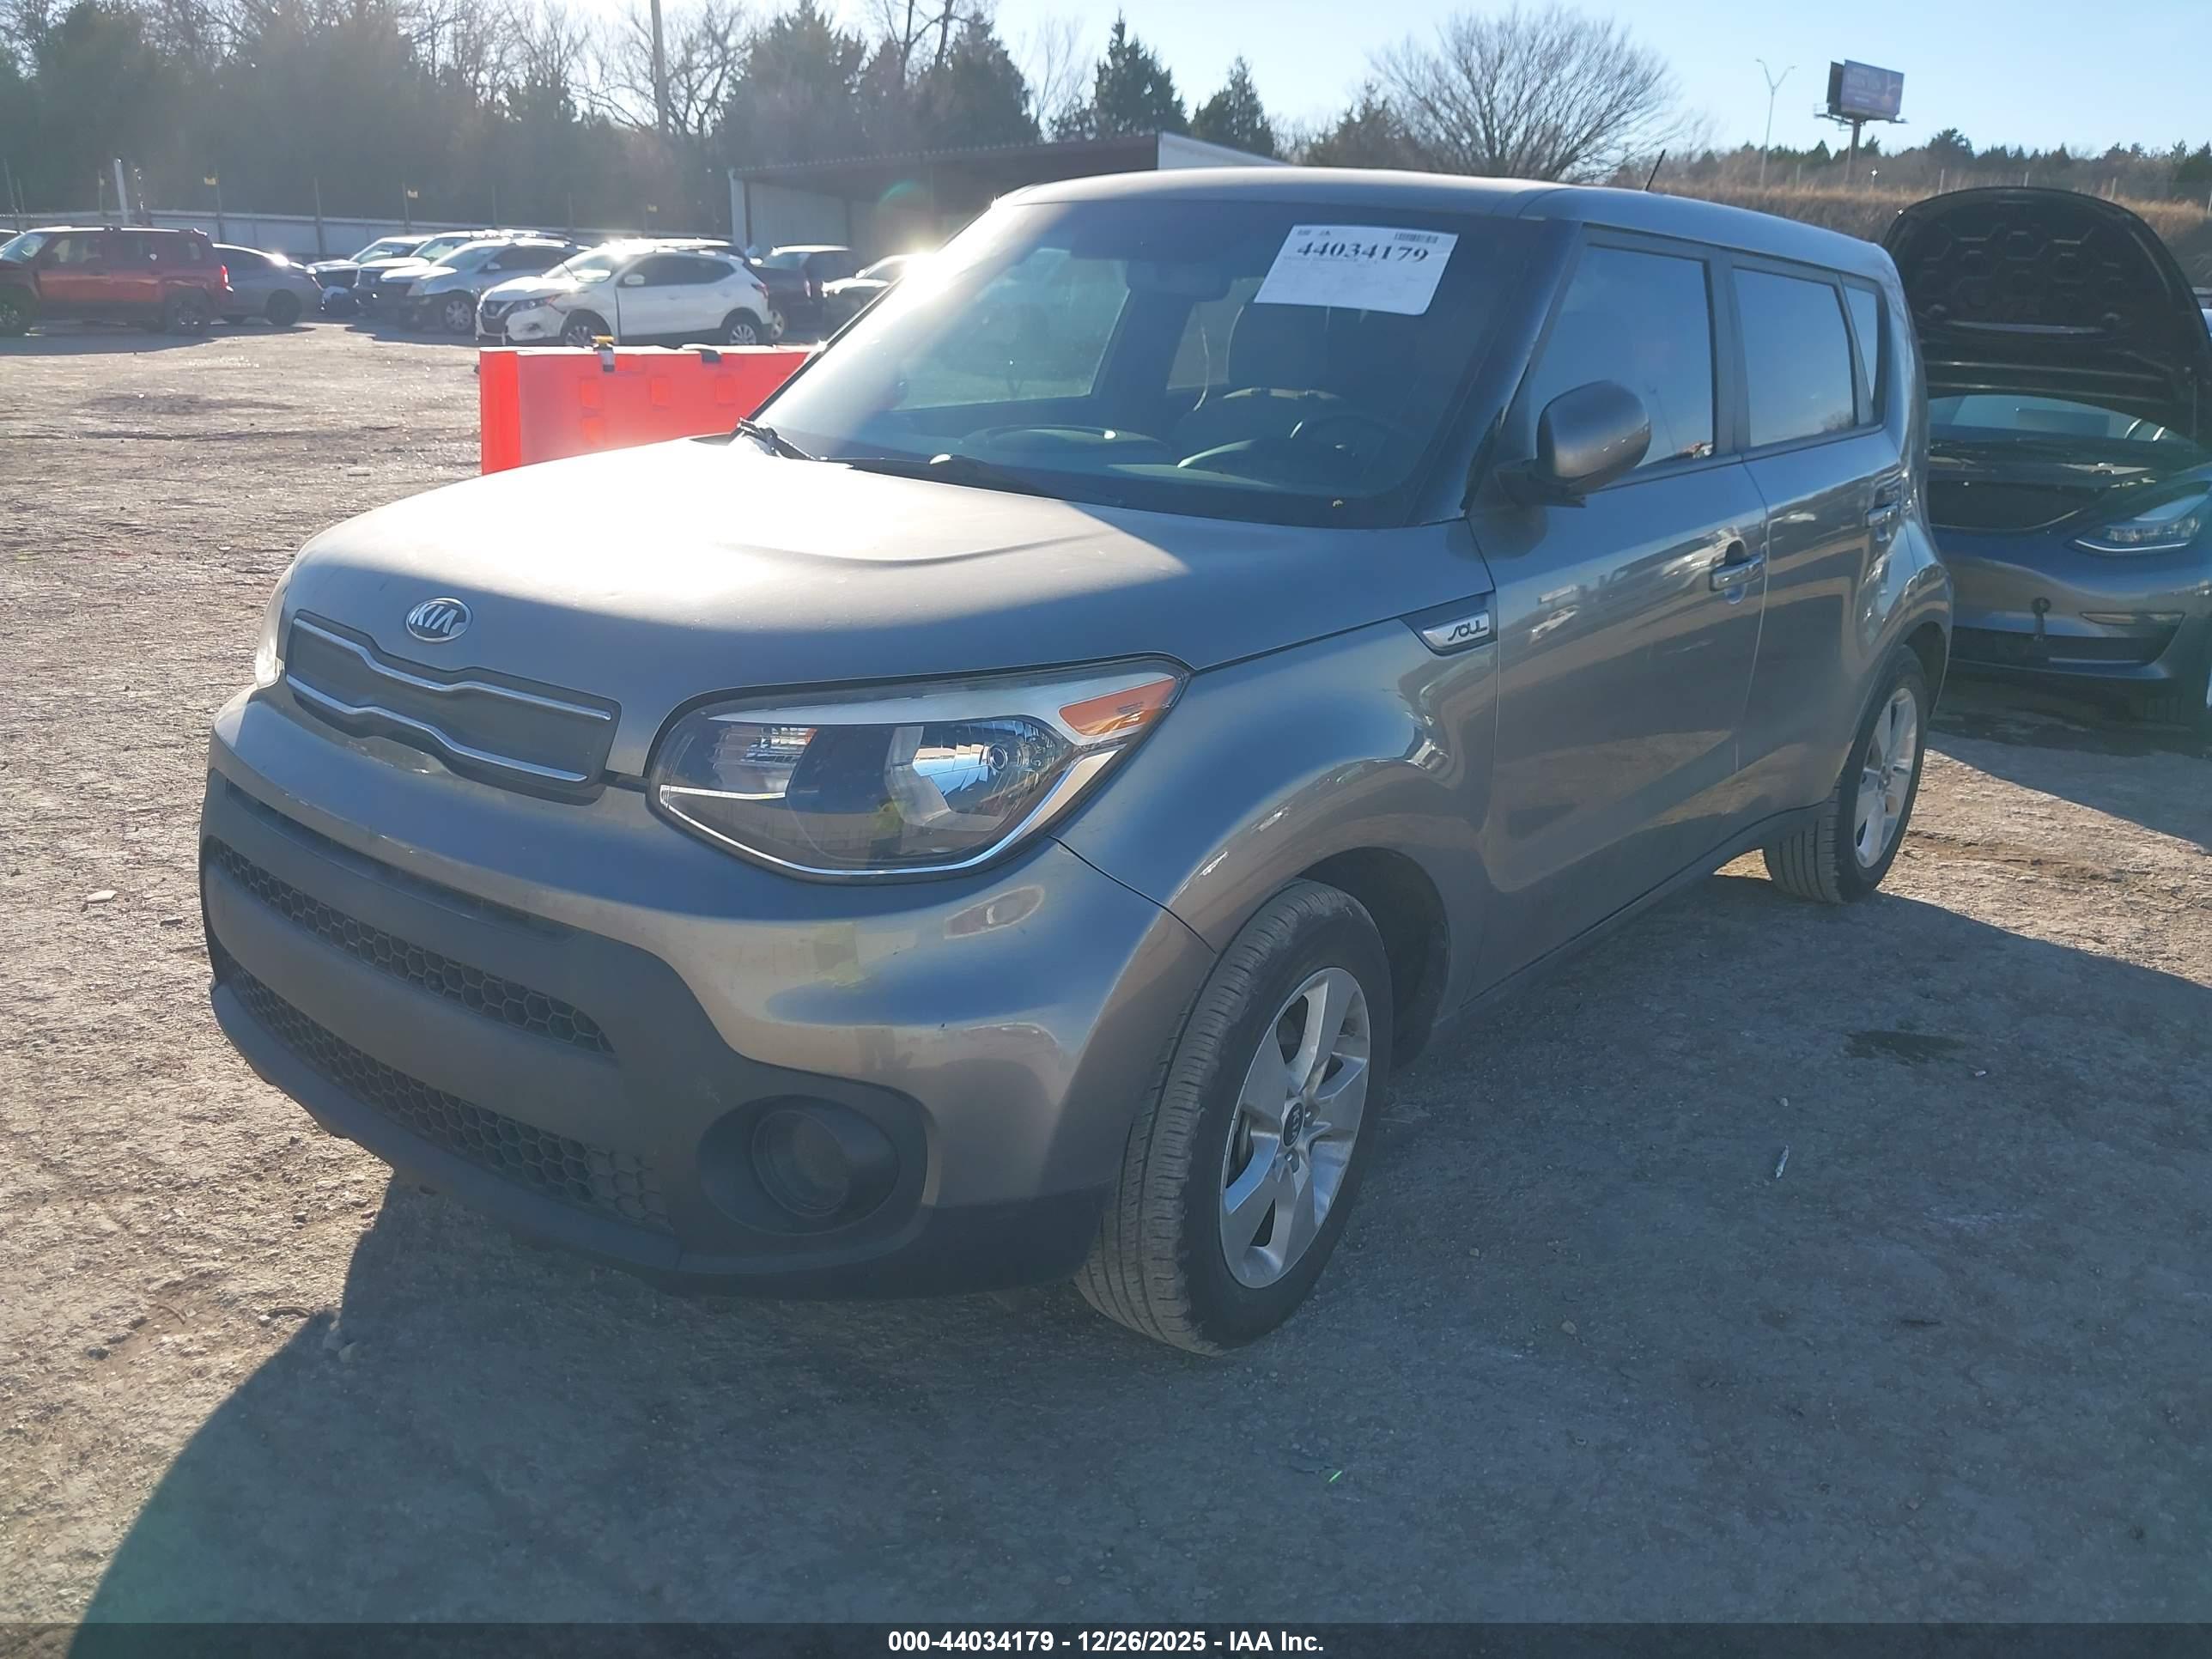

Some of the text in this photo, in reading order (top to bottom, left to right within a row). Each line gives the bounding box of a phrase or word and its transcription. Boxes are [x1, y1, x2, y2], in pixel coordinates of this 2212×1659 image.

[1297, 241, 1429, 263] 44034179
[410, 603, 458, 634] KIA
[1448, 620, 1488, 641] SOUL
